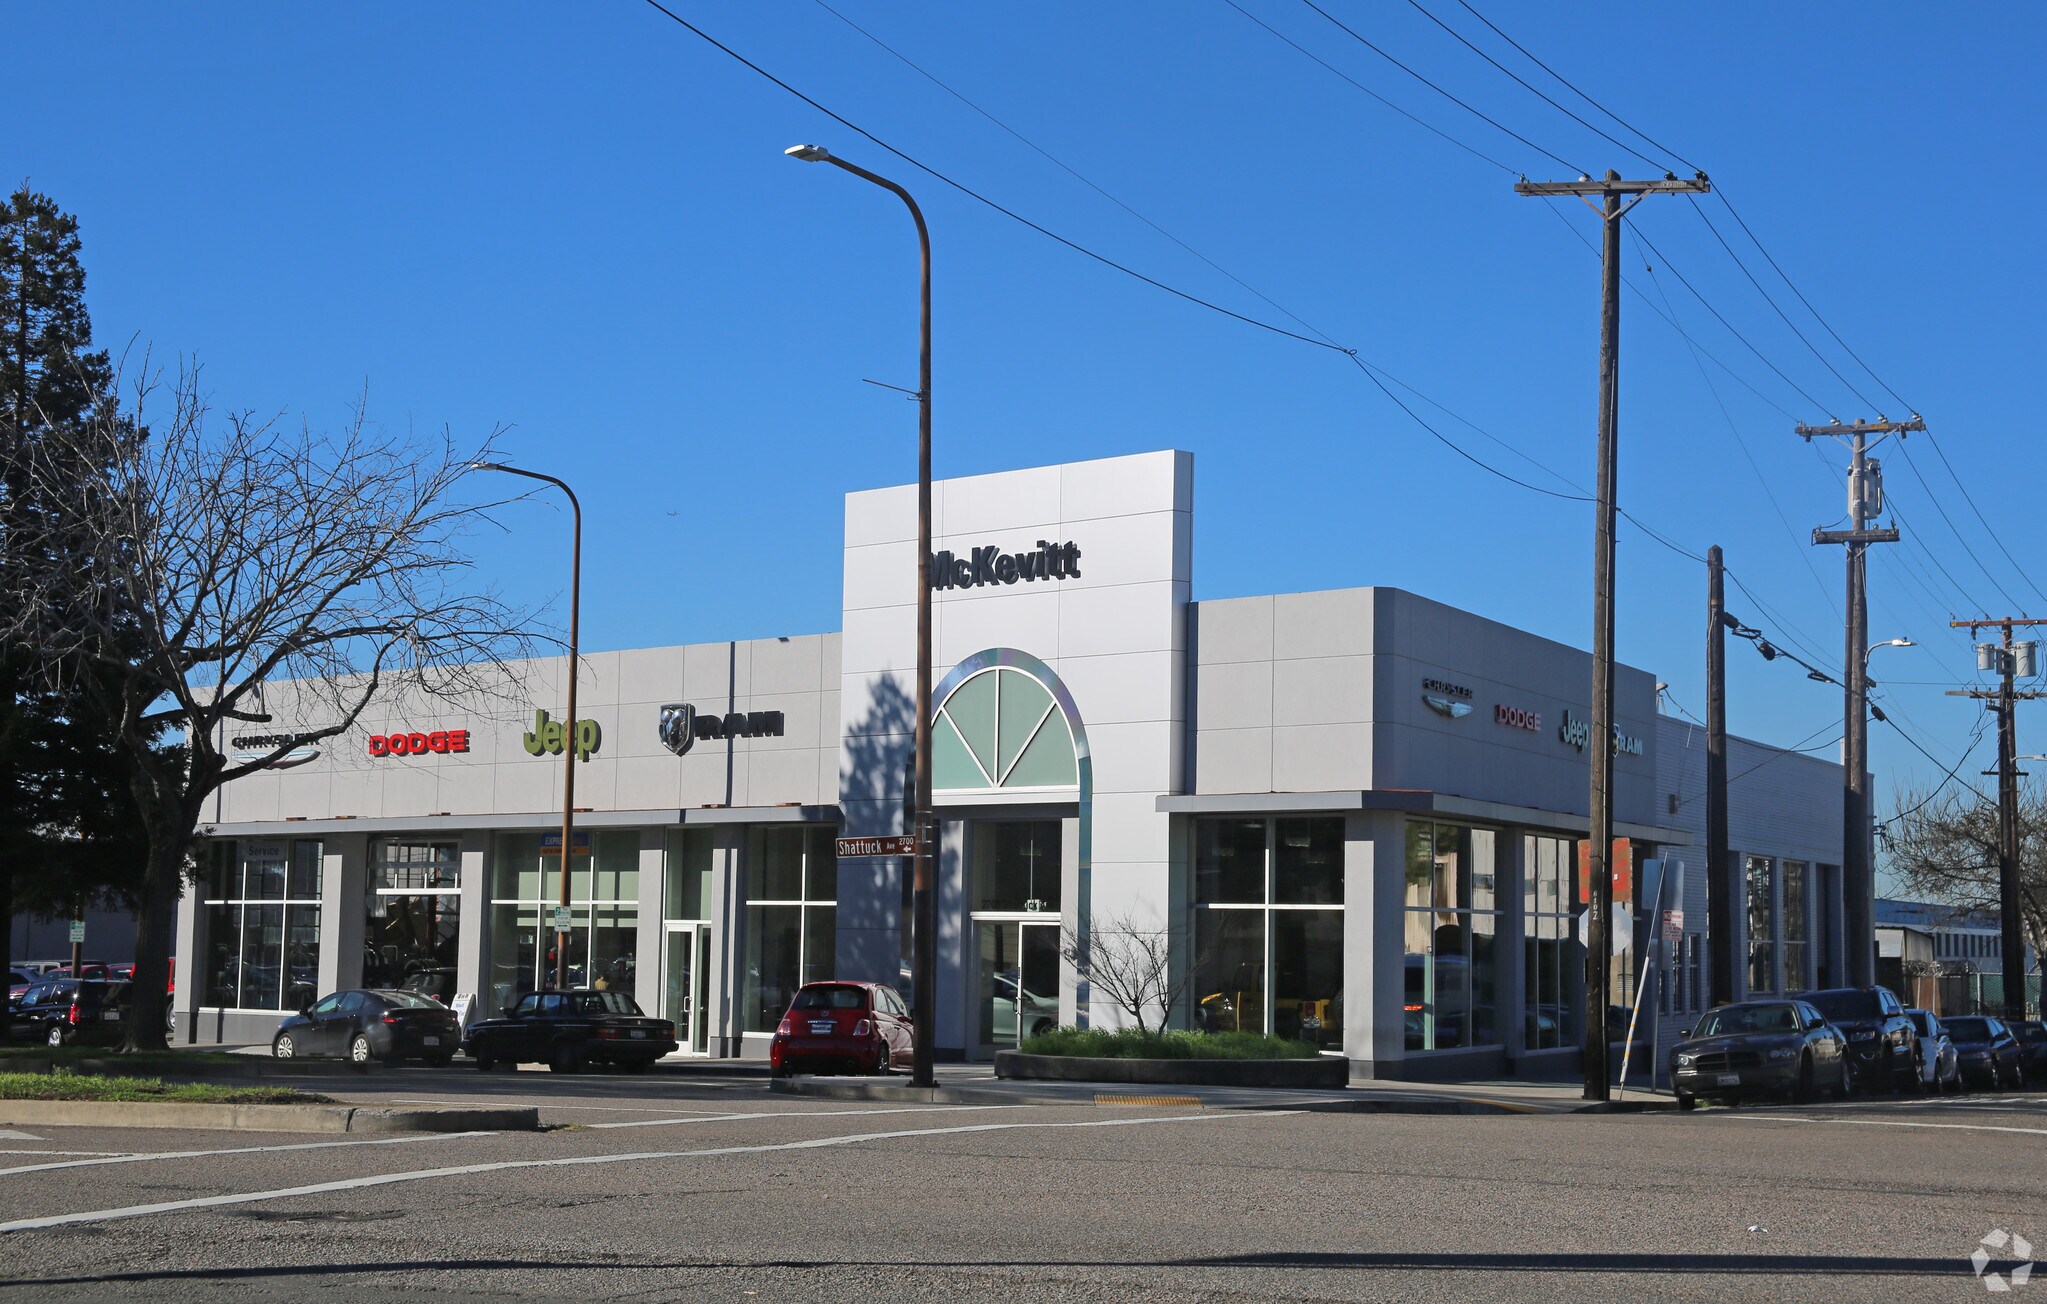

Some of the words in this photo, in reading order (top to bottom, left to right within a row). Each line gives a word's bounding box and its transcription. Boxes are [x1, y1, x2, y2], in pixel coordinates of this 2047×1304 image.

[1423, 679, 1473, 699] CHRYSLER
[695, 711, 784, 740] RAM
[1496, 704, 1541, 731] DODGE
[1562, 710, 1589, 751] Jeep
[369, 730, 470, 757] DODGE
[1619, 737, 1643, 755] RAM
[249, 846, 280, 856] Service
[839, 840, 882, 855] Shattuck
[898, 837, 914, 846] 2700
